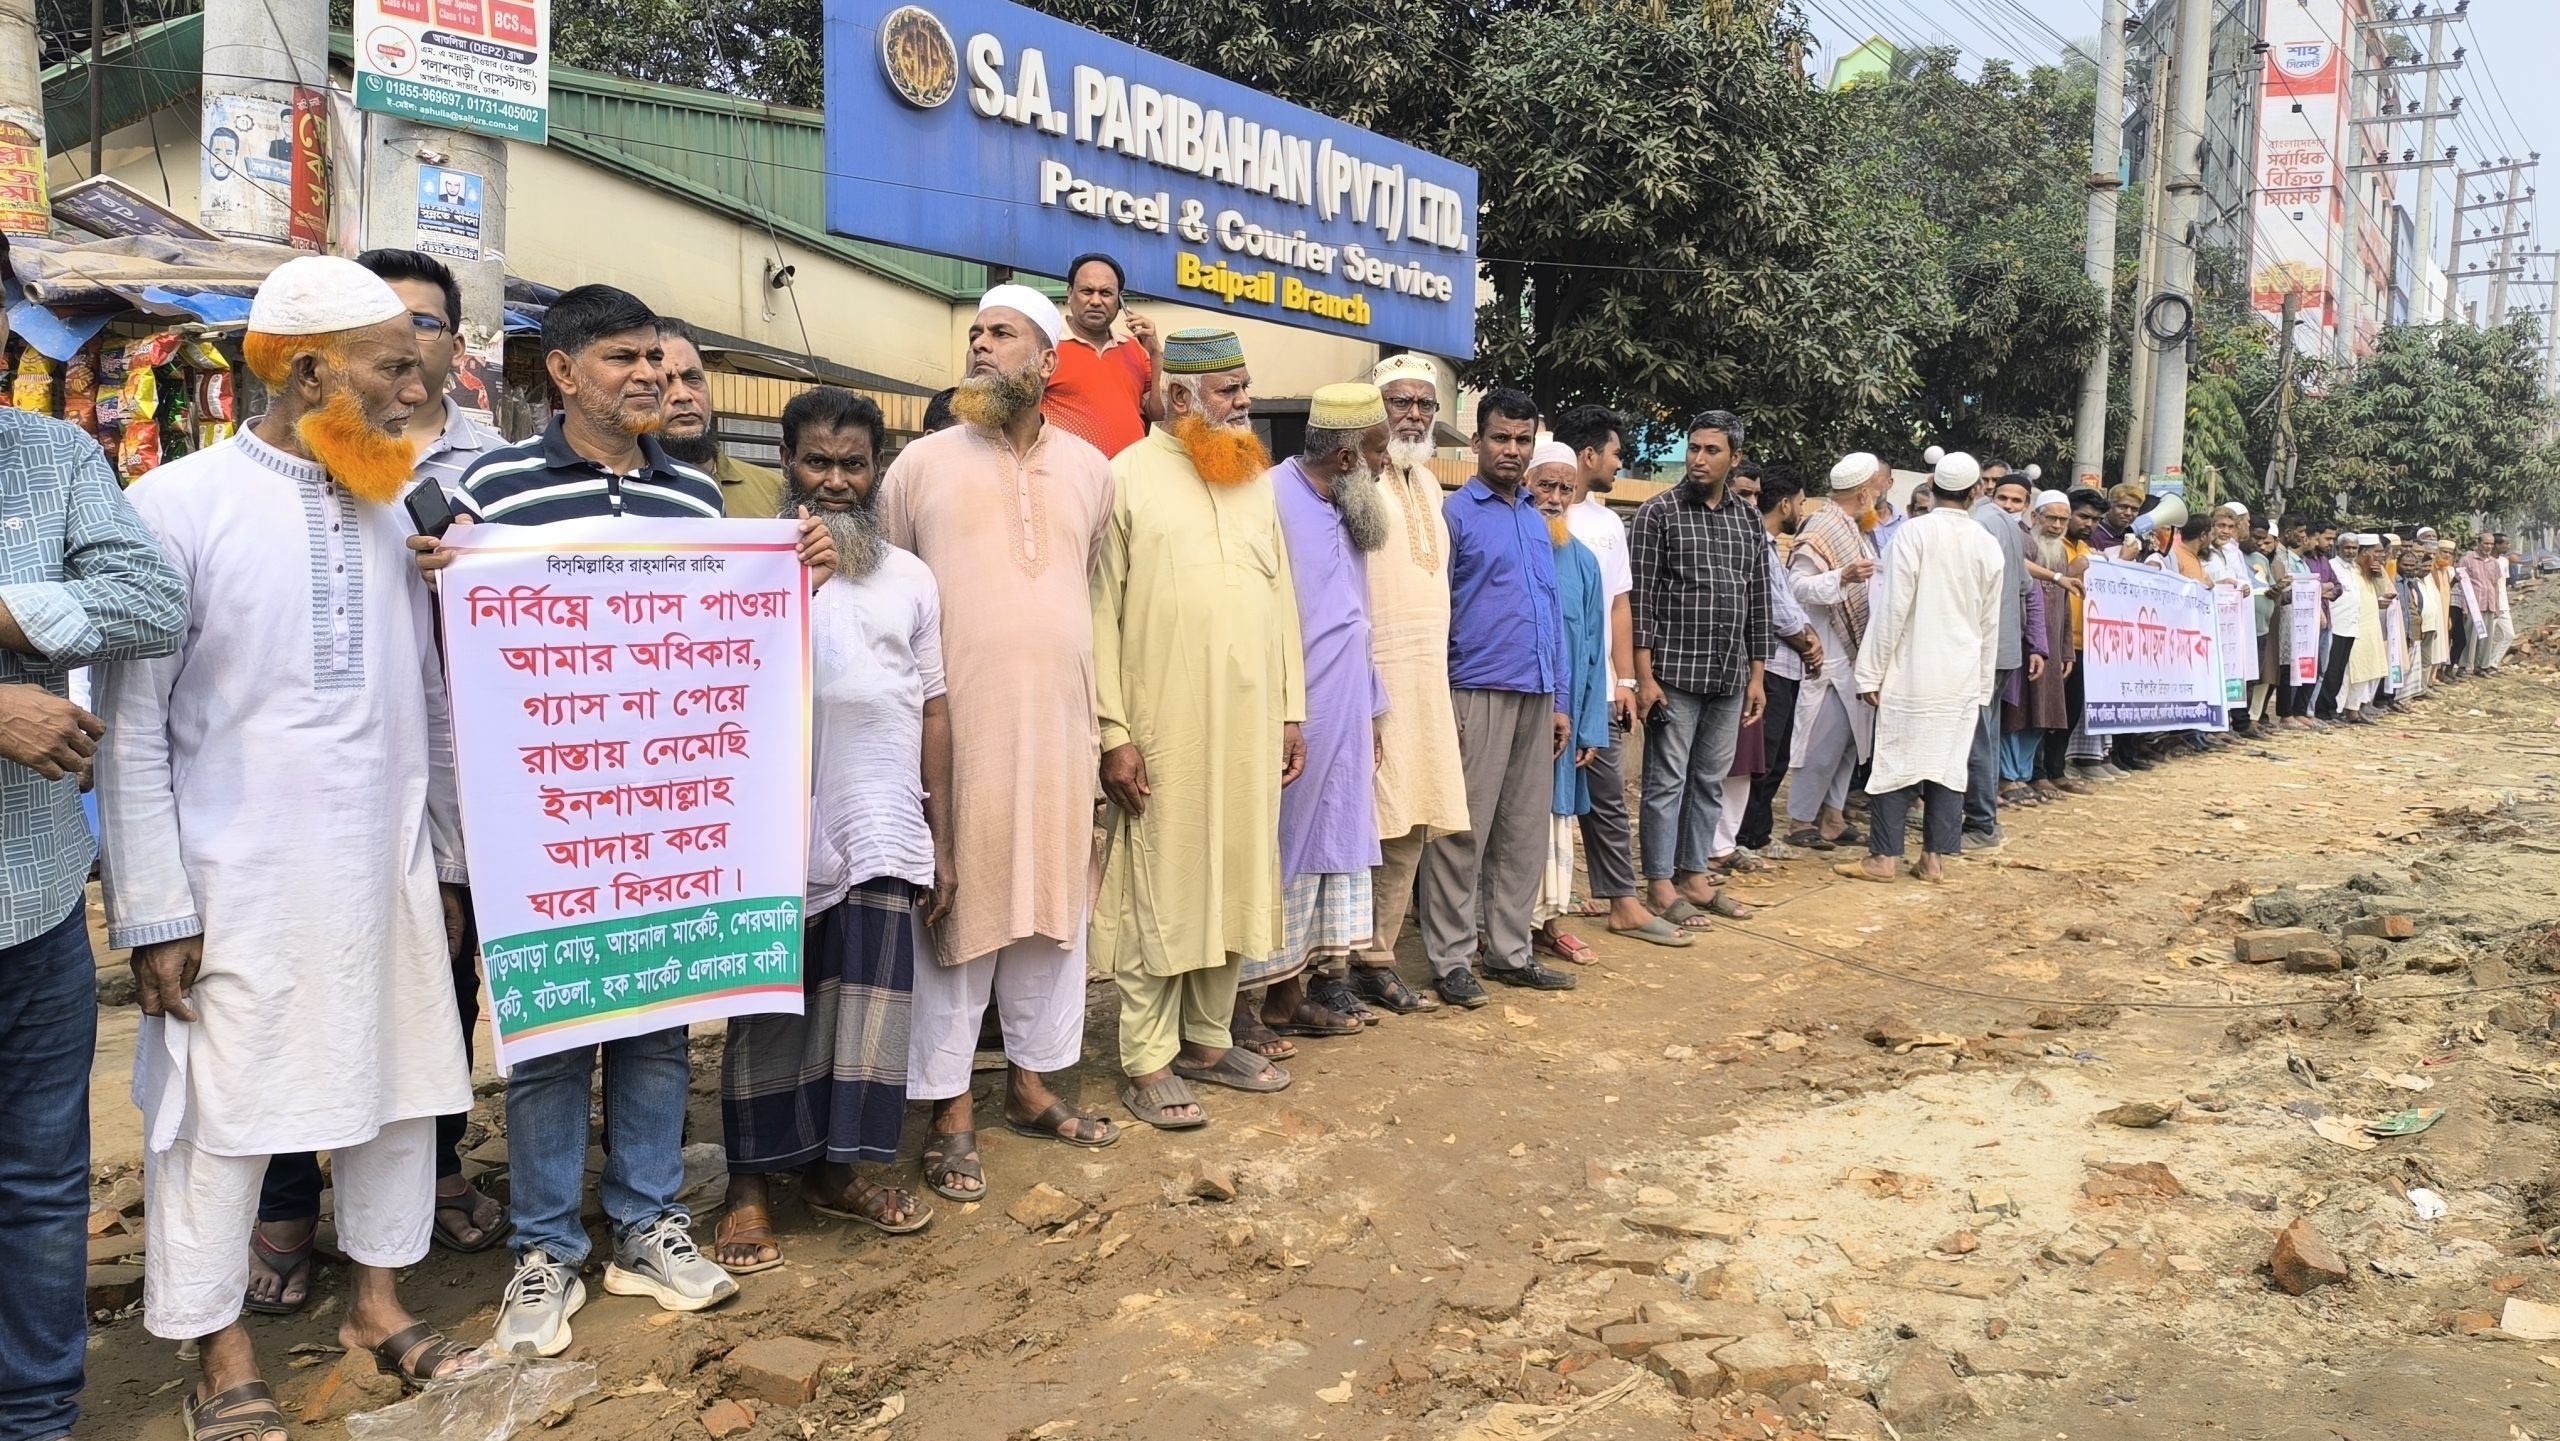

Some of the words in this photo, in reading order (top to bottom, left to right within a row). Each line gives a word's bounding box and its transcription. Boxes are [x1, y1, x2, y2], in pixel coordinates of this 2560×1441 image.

[408, 3, 414, 11] to
[439, 10, 457, 21] Class
[463, 14, 470, 24] to
[471, 16, 476, 26] 3
[455, 0, 477, 12] Spoken
[495, 10, 519, 32] BCS
[520, 25, 533, 36] Plus
[432, 32, 467, 50] আশুলিয়া
[469, 41, 506, 60] (DEPZ)
[421, 59, 475, 81] পলাশবাড়ী
[479, 70, 537, 96] (বাসস্ট্যান্ড)
[467, 97, 538, 123] 01731-405002
[966, 33, 1067, 135] S.A.
[1075, 64, 1312, 206] PARIBAHAN
[1317, 138, 1405, 242] (PVT)
[1407, 178, 1468, 252] LTD.
[2268, 149, 2325, 166] সর্বাধিক
[2264, 186, 2321, 206] সিমেন্ট
[1041, 160, 1169, 233] Parcel
[1177, 199, 1209, 244] &
[1216, 210, 1339, 274] Courier
[1343, 243, 1452, 301] Service
[1176, 251, 1275, 304] Baipail
[1282, 277, 1370, 325] Branch
[691, 555, 726, 573] রাহিম
[465, 583, 594, 632] নির্বিঘ্নে
[606, 590, 688, 625] গ্যাস
[700, 587, 792, 622] পাওয়া
[499, 641, 618, 677] আমার
[626, 631, 762, 672] অধিকার,
[2087, 599, 2134, 665] বিক্ষোভ
[2137, 606, 2167, 672] মিছিল
[523, 691, 611, 727] গ্যাস
[618, 687, 661, 721] না
[673, 684, 750, 717] পেয়ে
[518, 738, 631, 776] রাস্তায়
[643, 721, 750, 766] নেমেছি
[538, 775, 735, 824] ইনশাআল্লাহ
[542, 831, 655, 869] আদায়
[661, 822, 731, 855] করে
[526, 886, 600, 921] ঘরে
[554, 935, 601, 966] মোড়,
[605, 923, 668, 956] আয়নাল
[672, 907, 725, 943] মার্কেট,
[730, 901, 799, 936] শেরআলি
[532, 977, 597, 1014] বটতলা,
[601, 973, 631, 1002] হক
[634, 956, 683, 993] মার্কেট
[686, 950, 749, 984] এলাকার
